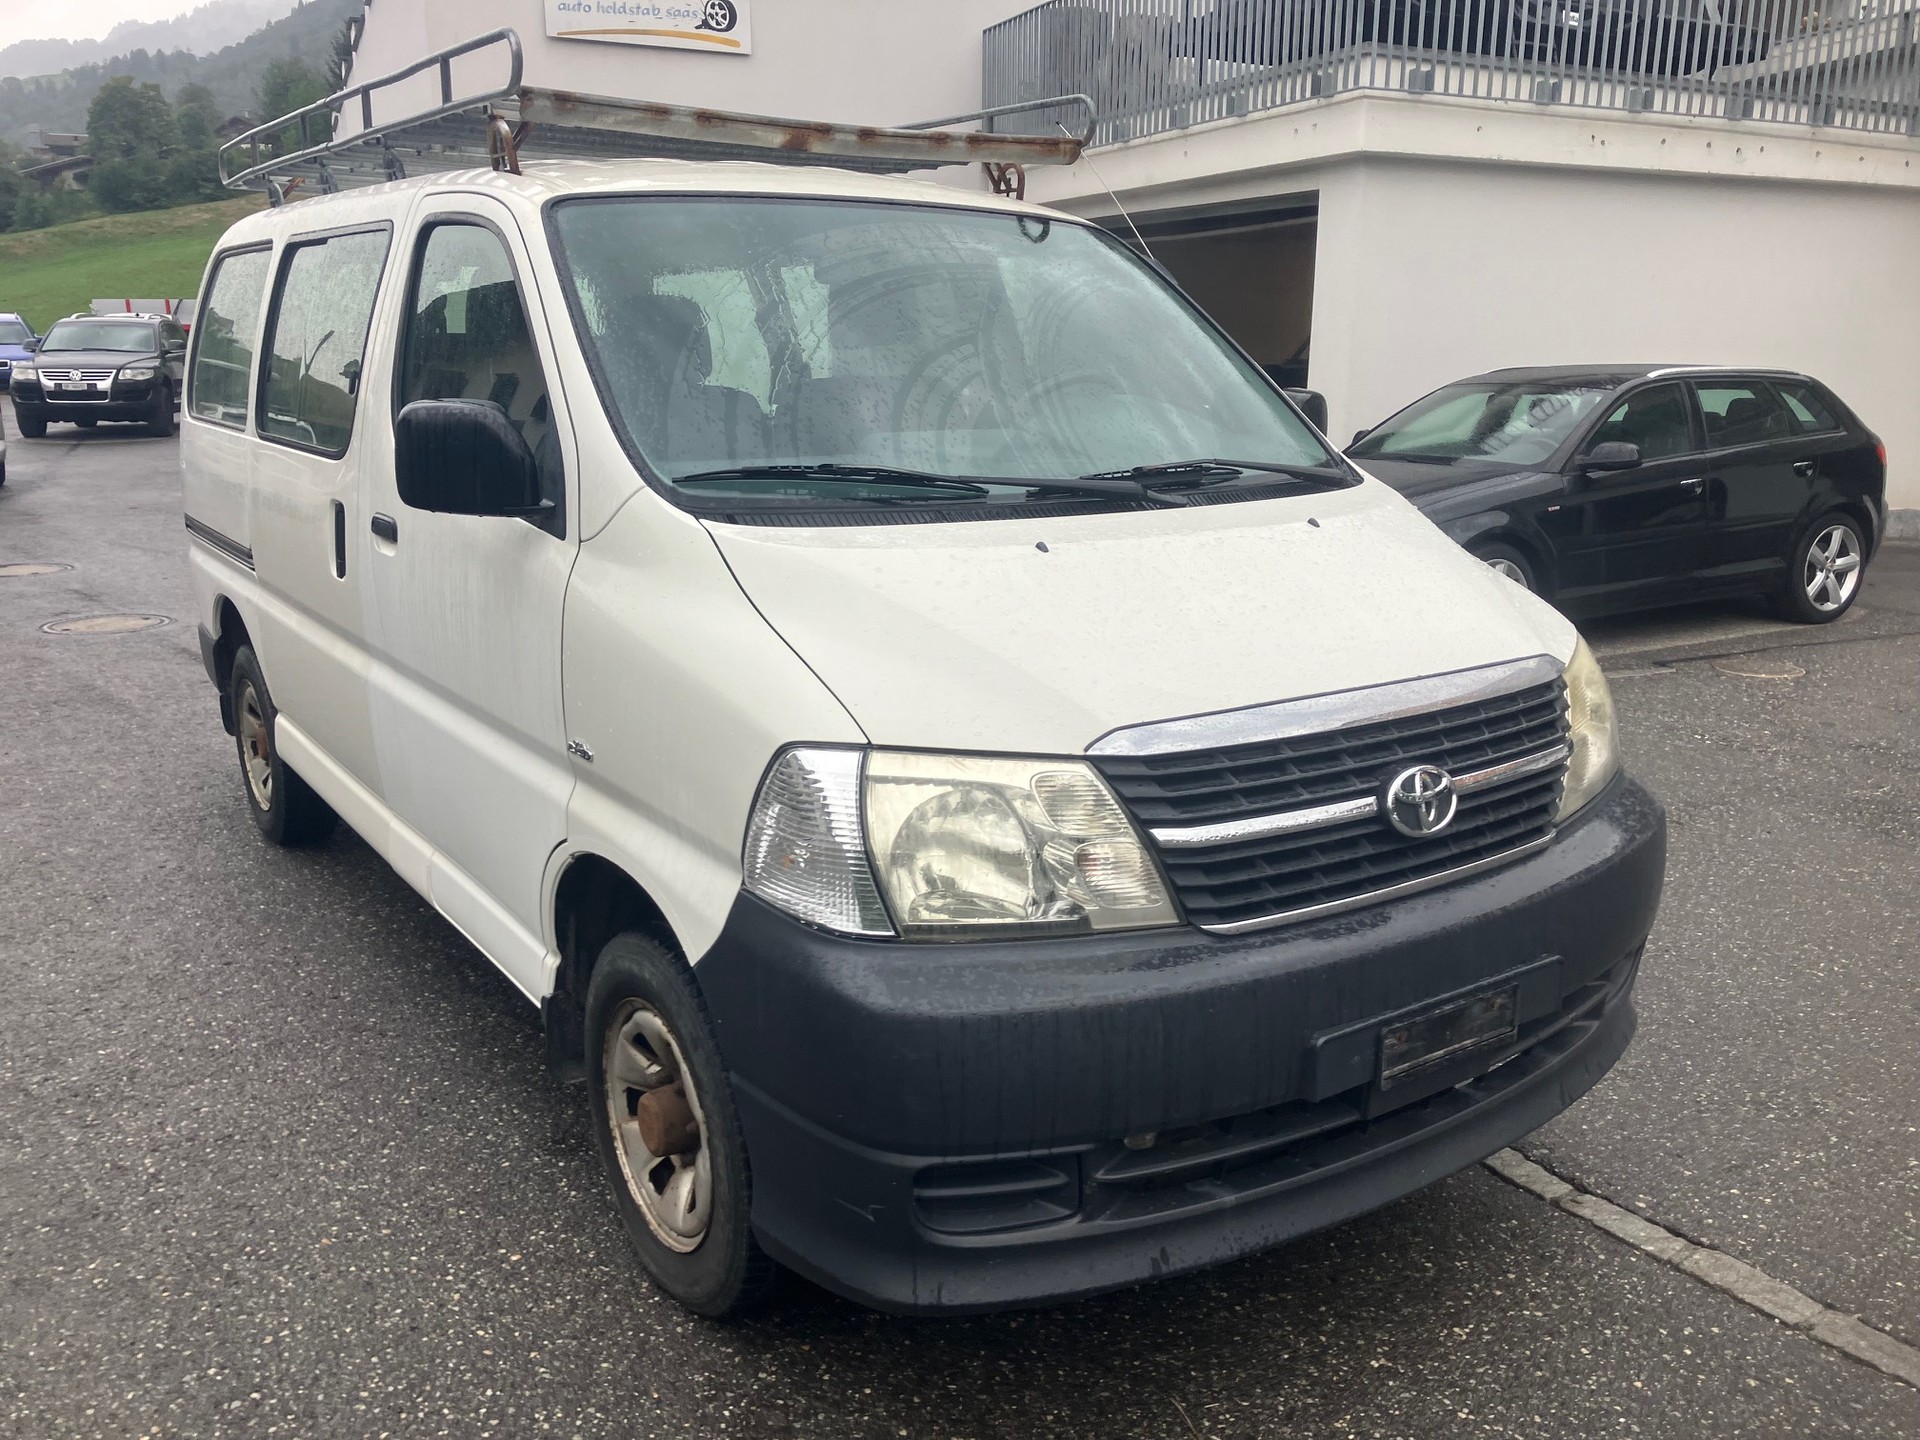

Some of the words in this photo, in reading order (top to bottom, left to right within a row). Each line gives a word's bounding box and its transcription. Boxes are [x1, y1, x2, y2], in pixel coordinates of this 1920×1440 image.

[558, 1, 592, 13] auto
[597, 1, 660, 16] heldstab
[666, 8, 698, 18] saas
